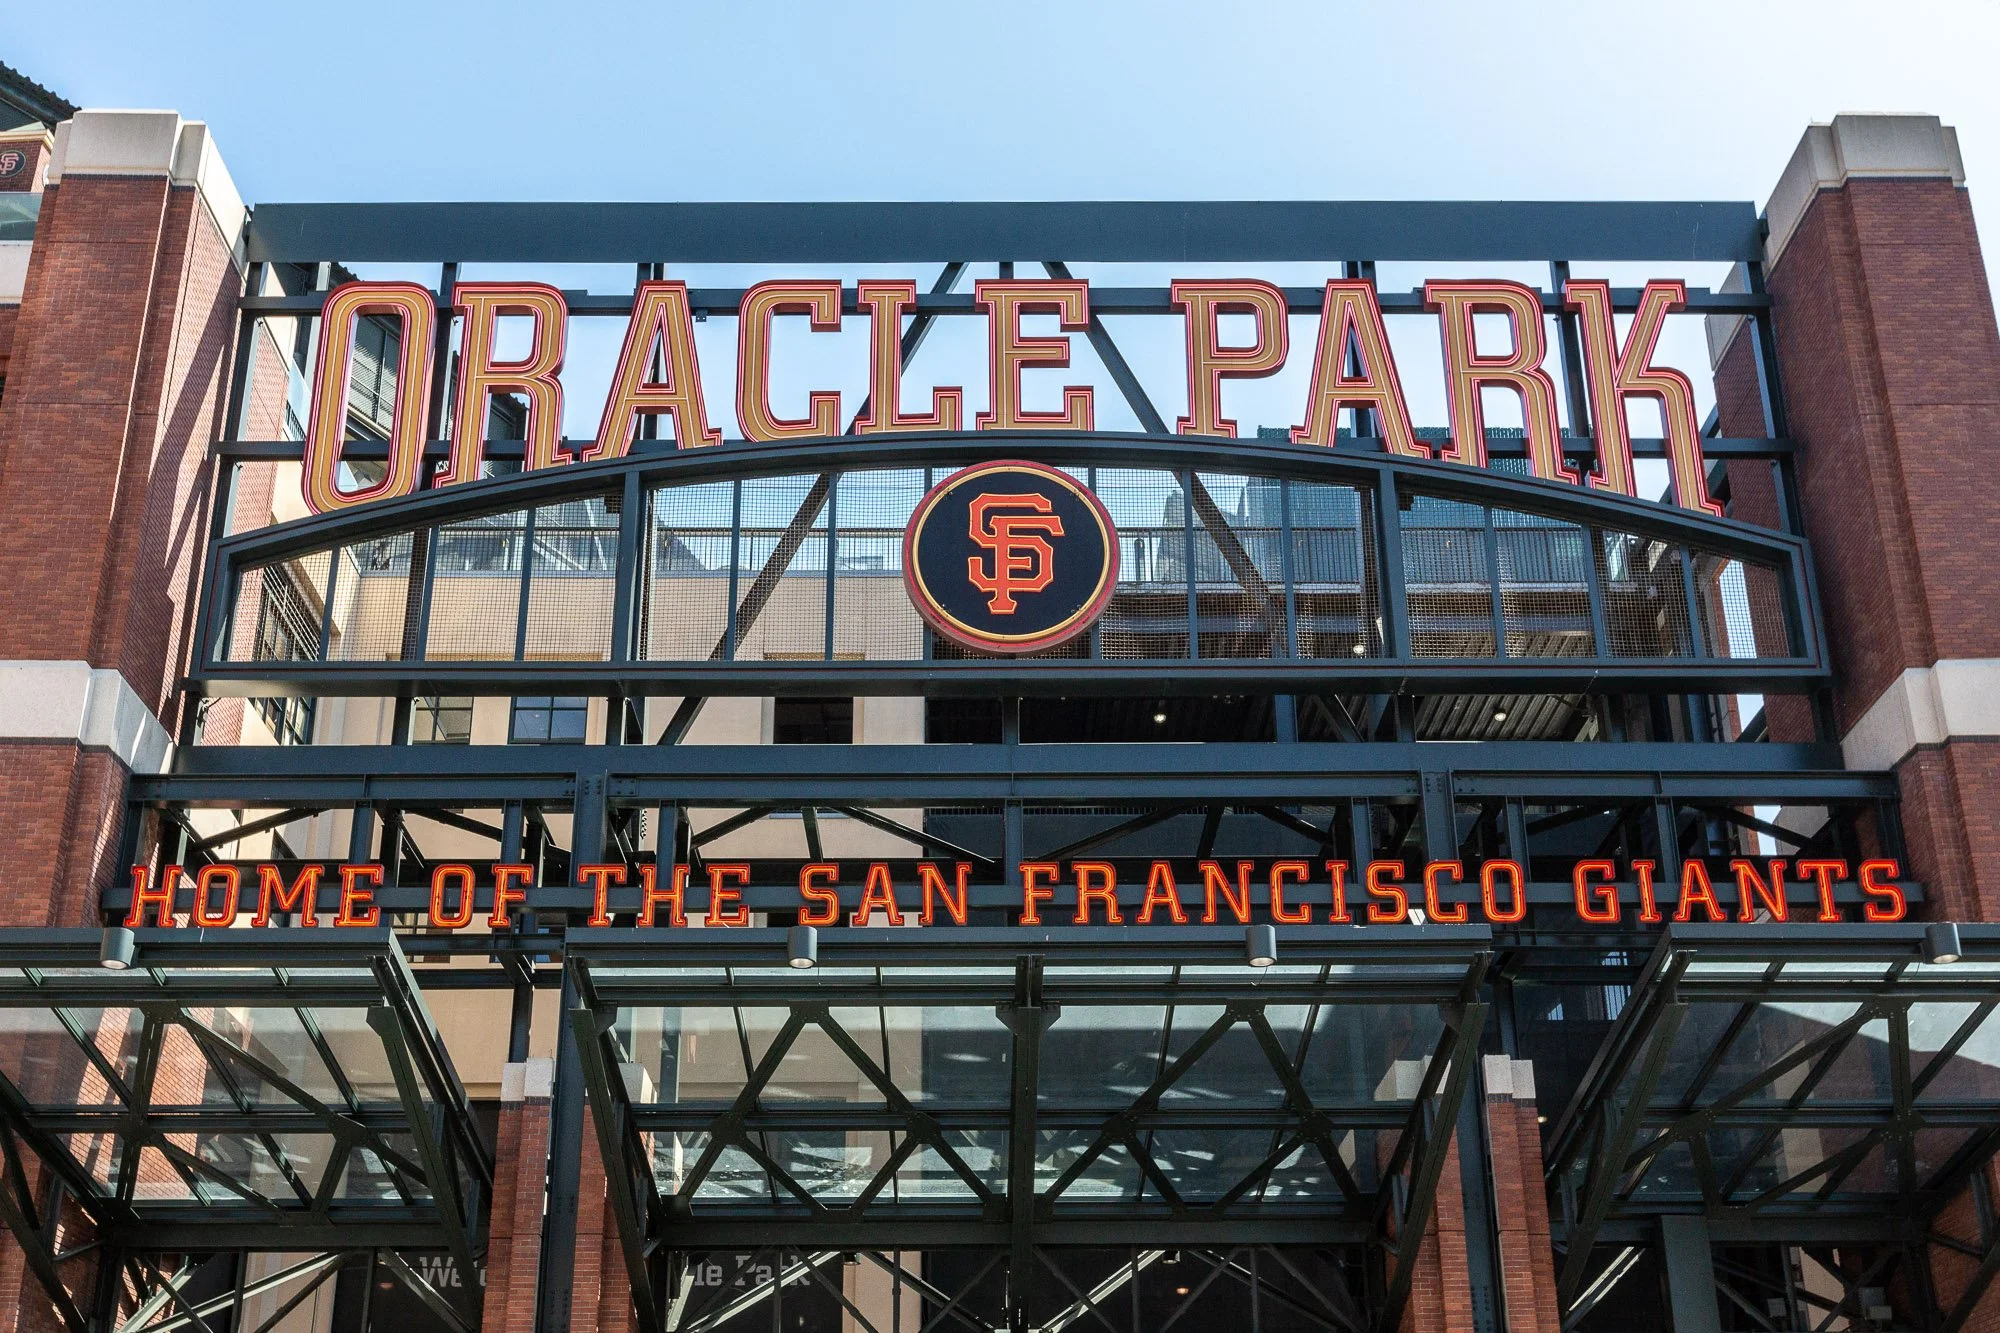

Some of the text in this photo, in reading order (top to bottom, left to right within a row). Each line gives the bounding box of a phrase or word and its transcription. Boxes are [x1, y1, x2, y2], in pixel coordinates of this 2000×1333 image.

[306, 279, 1725, 517] ORACLE PARK
[968, 492, 1065, 615] SF
[124, 859, 1908, 928] HOME OF THE SAN FRANCISCO GIANTS
